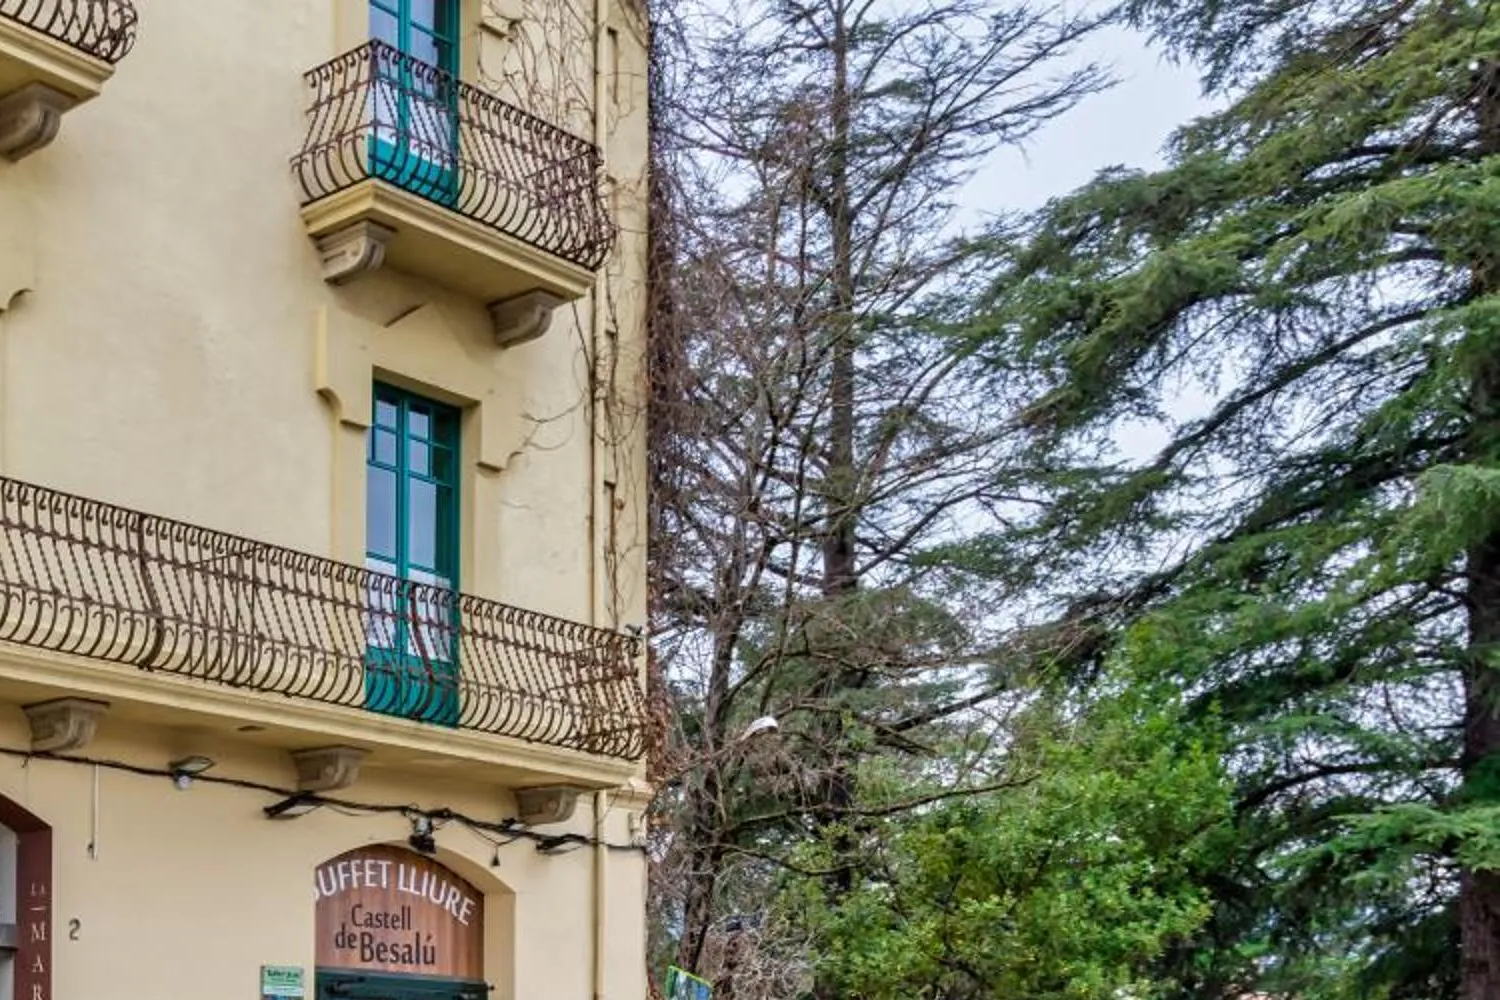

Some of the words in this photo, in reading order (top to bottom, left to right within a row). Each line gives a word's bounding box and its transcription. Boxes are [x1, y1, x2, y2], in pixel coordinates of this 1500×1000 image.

[397, 863, 477, 927] LLIURE
[68, 918, 81, 941] 2
[351, 903, 412, 931] Castell
[335, 922, 357, 949] de
[359, 931, 436, 966] Besalú
